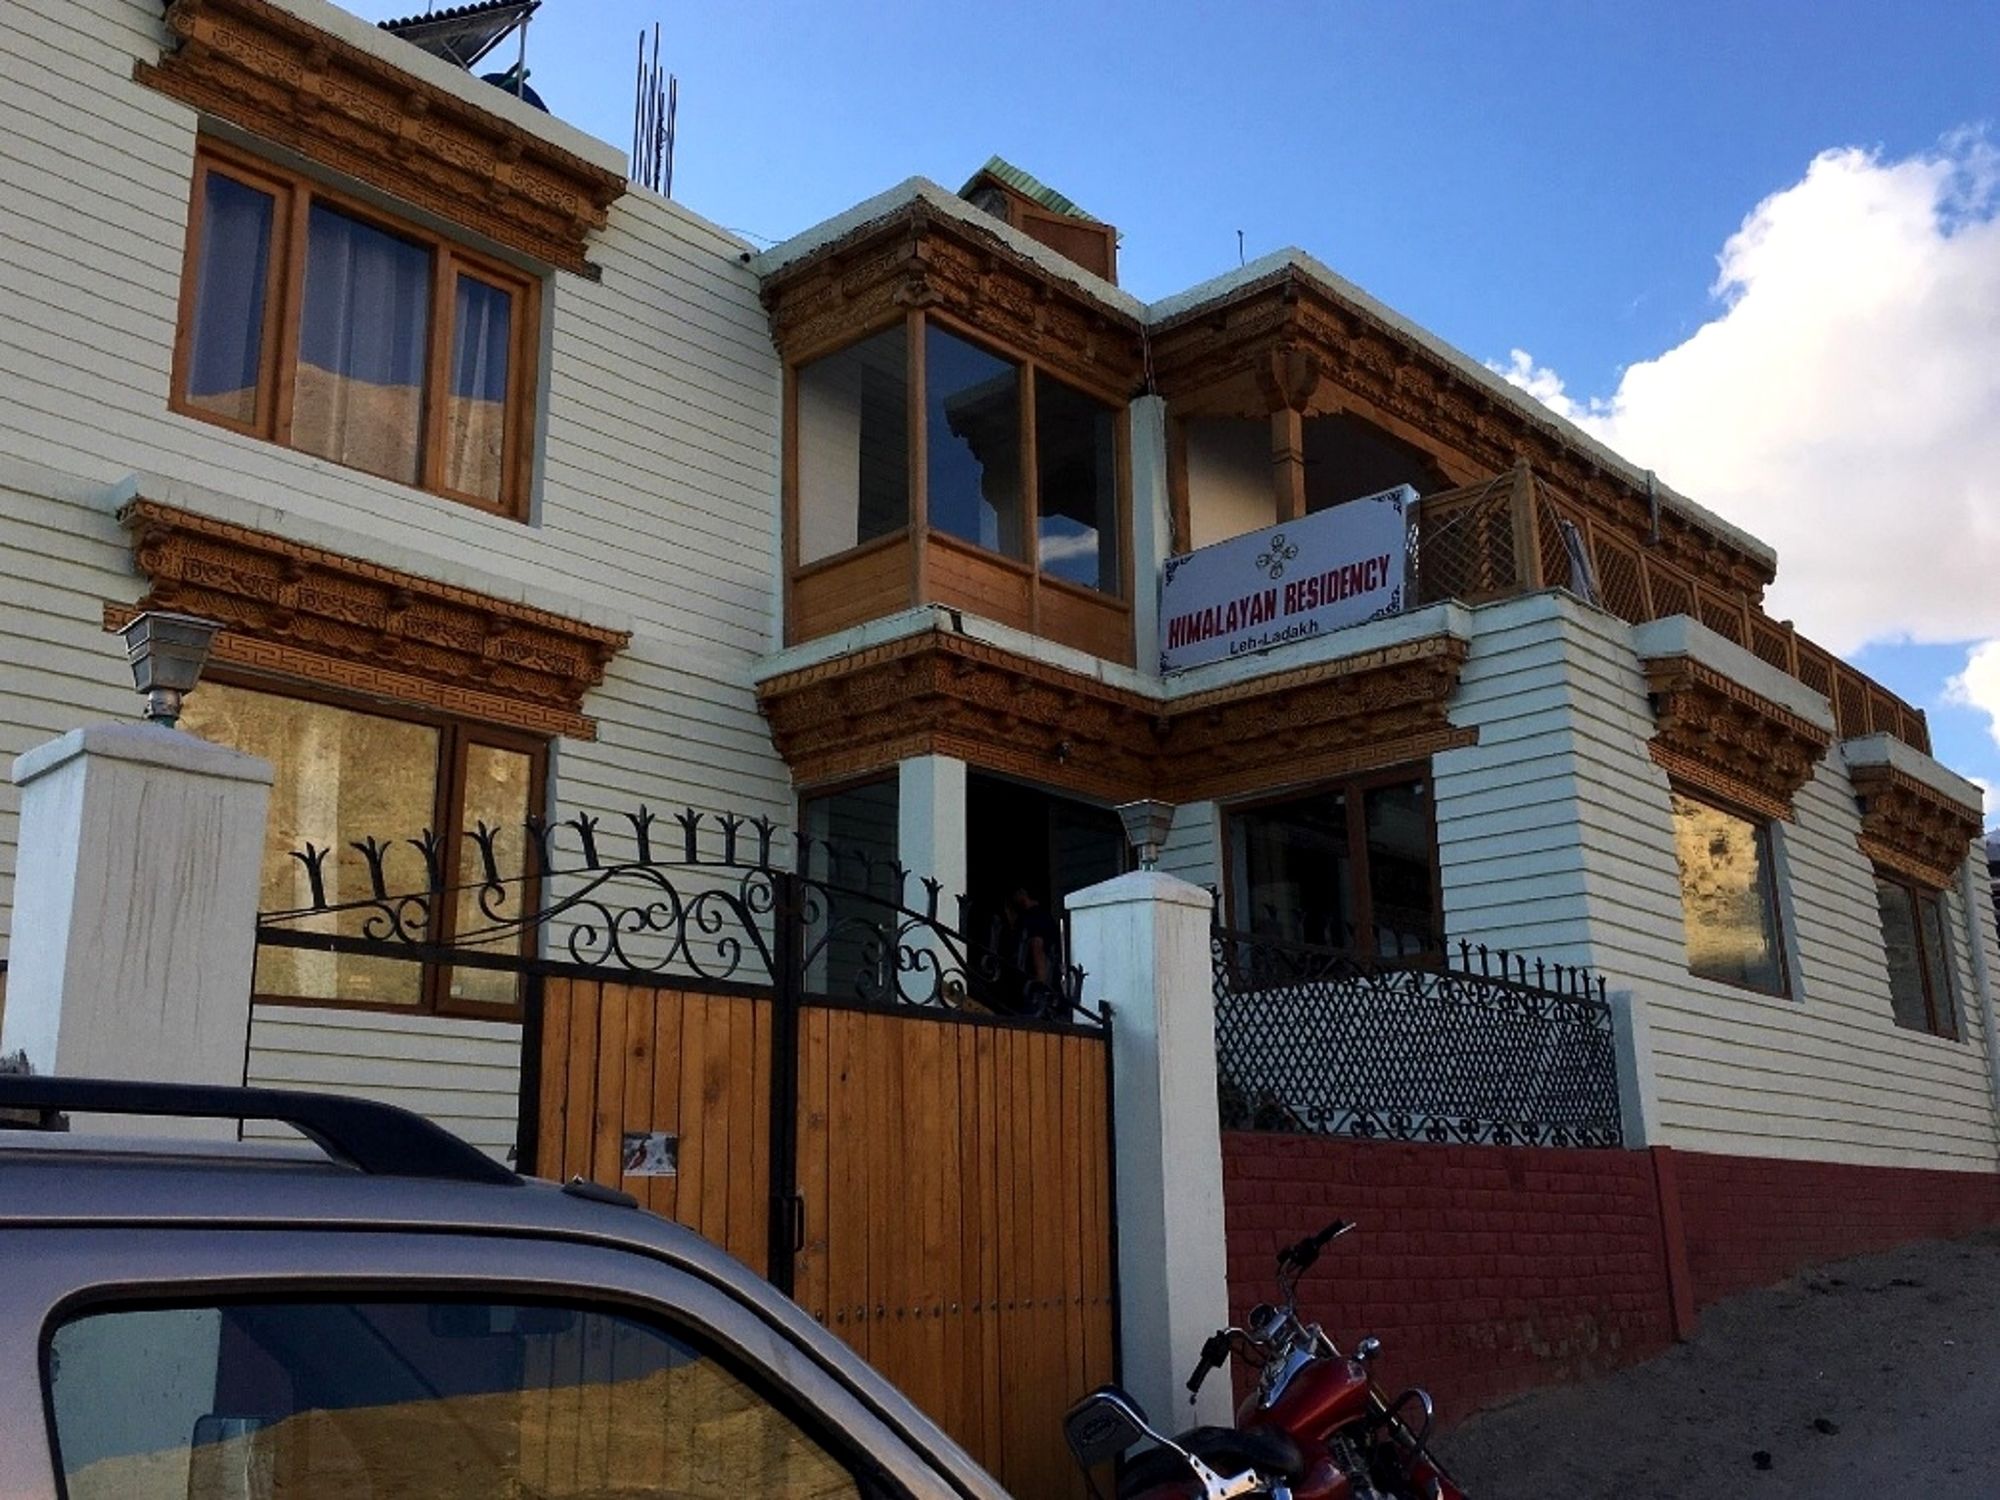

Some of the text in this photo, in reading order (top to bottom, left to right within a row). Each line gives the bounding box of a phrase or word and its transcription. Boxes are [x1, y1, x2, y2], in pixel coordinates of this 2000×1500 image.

[1168, 554, 1390, 650] HIMALAYAN RESIDENCY
[1230, 619, 1319, 654] Leh-Ladakh
